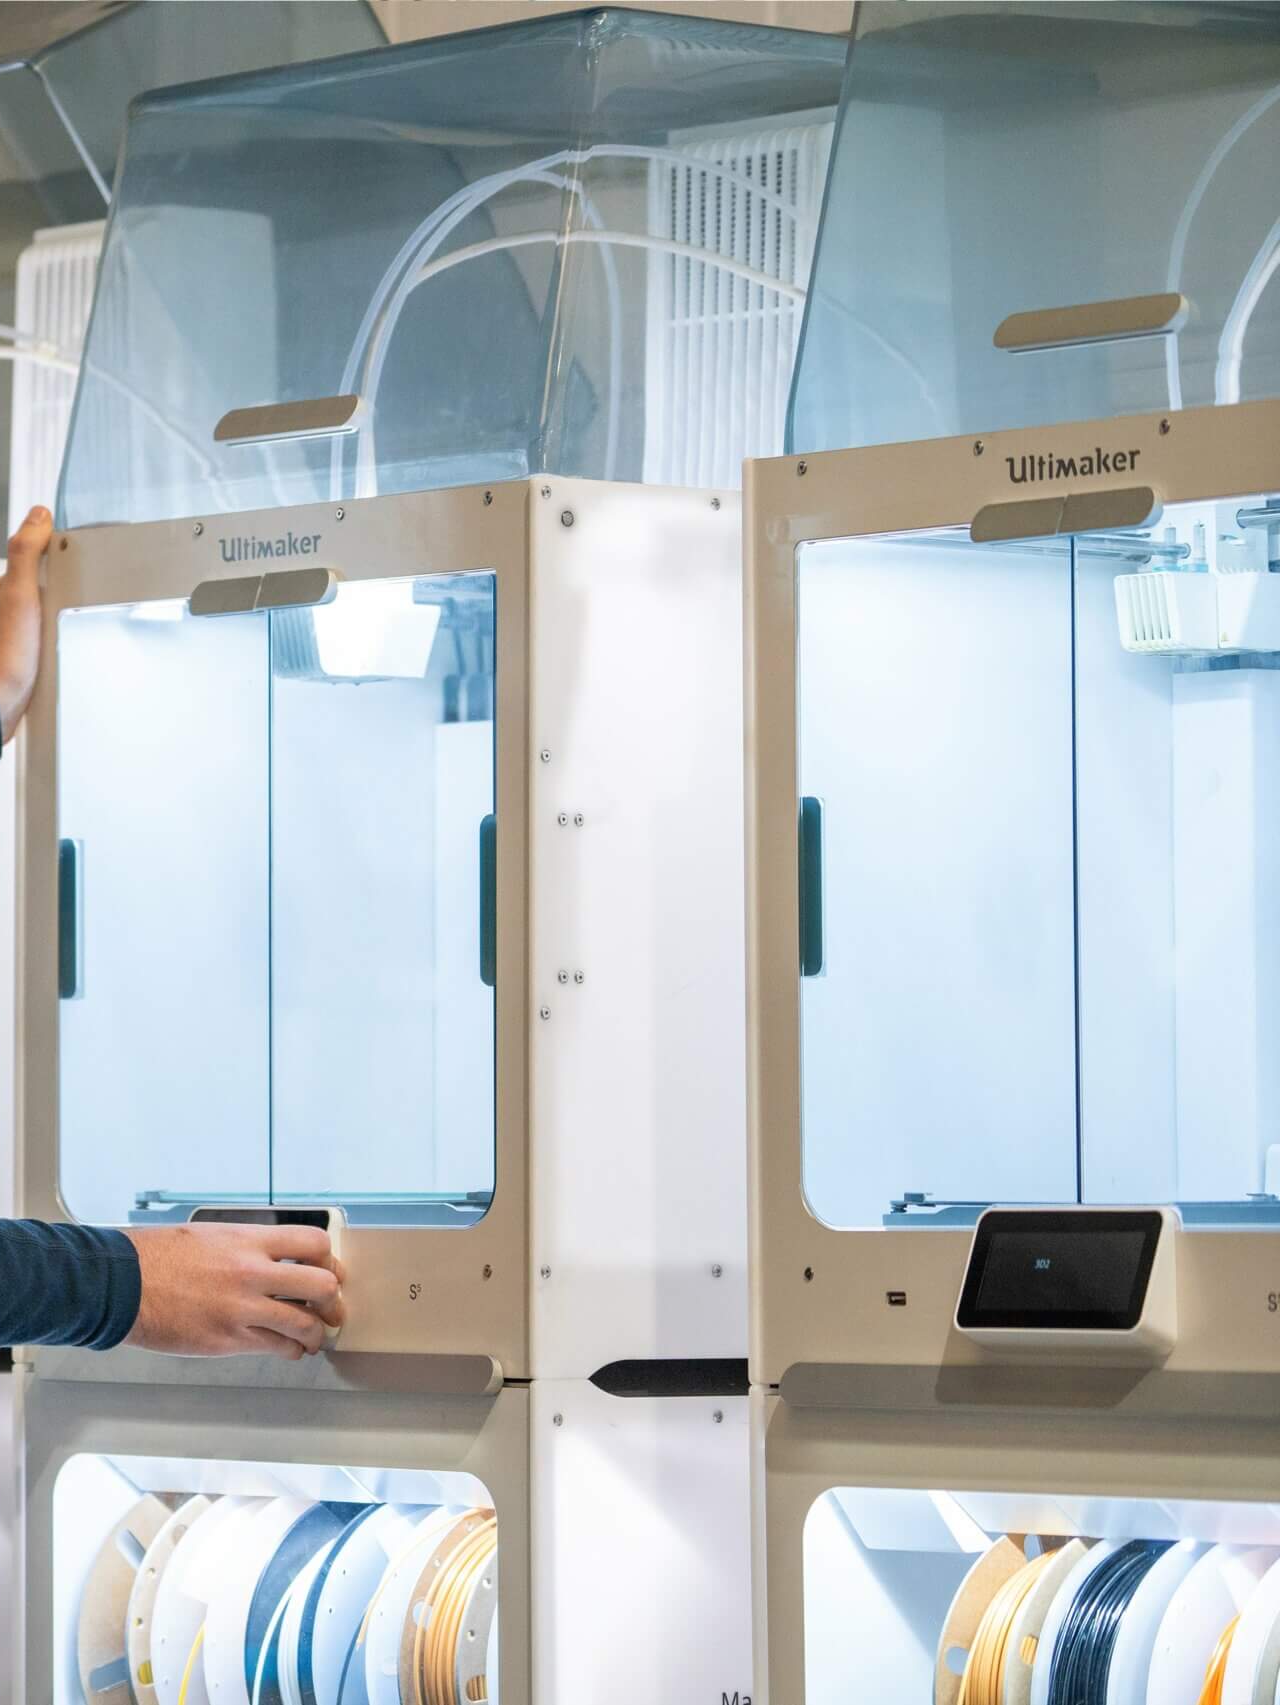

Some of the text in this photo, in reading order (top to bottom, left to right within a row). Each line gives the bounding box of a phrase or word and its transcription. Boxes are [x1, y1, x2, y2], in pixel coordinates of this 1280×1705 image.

[1005, 447, 1141, 484] Ultimaker
[219, 531, 322, 562] Ultimaker
[1268, 1292, 1280, 1312] S
